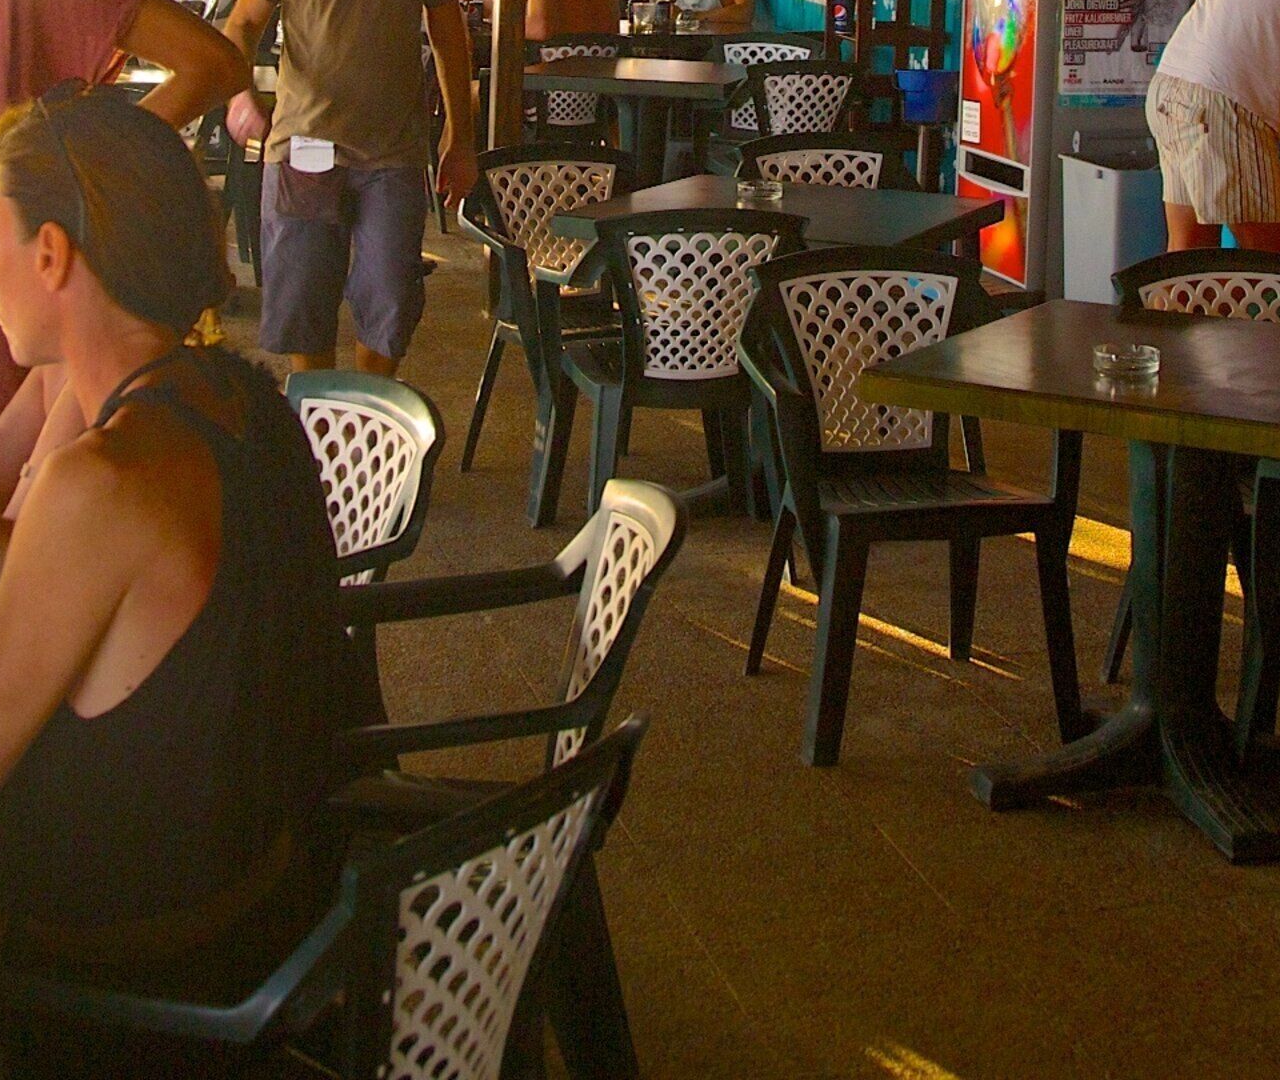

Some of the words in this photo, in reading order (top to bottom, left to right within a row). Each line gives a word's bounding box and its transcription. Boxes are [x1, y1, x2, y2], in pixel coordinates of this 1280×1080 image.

[1065, 0, 1084, 10] JOHN
[1086, 0, 1119, 10] DIGWEED
[1065, 13, 1084, 23] FRITZ
